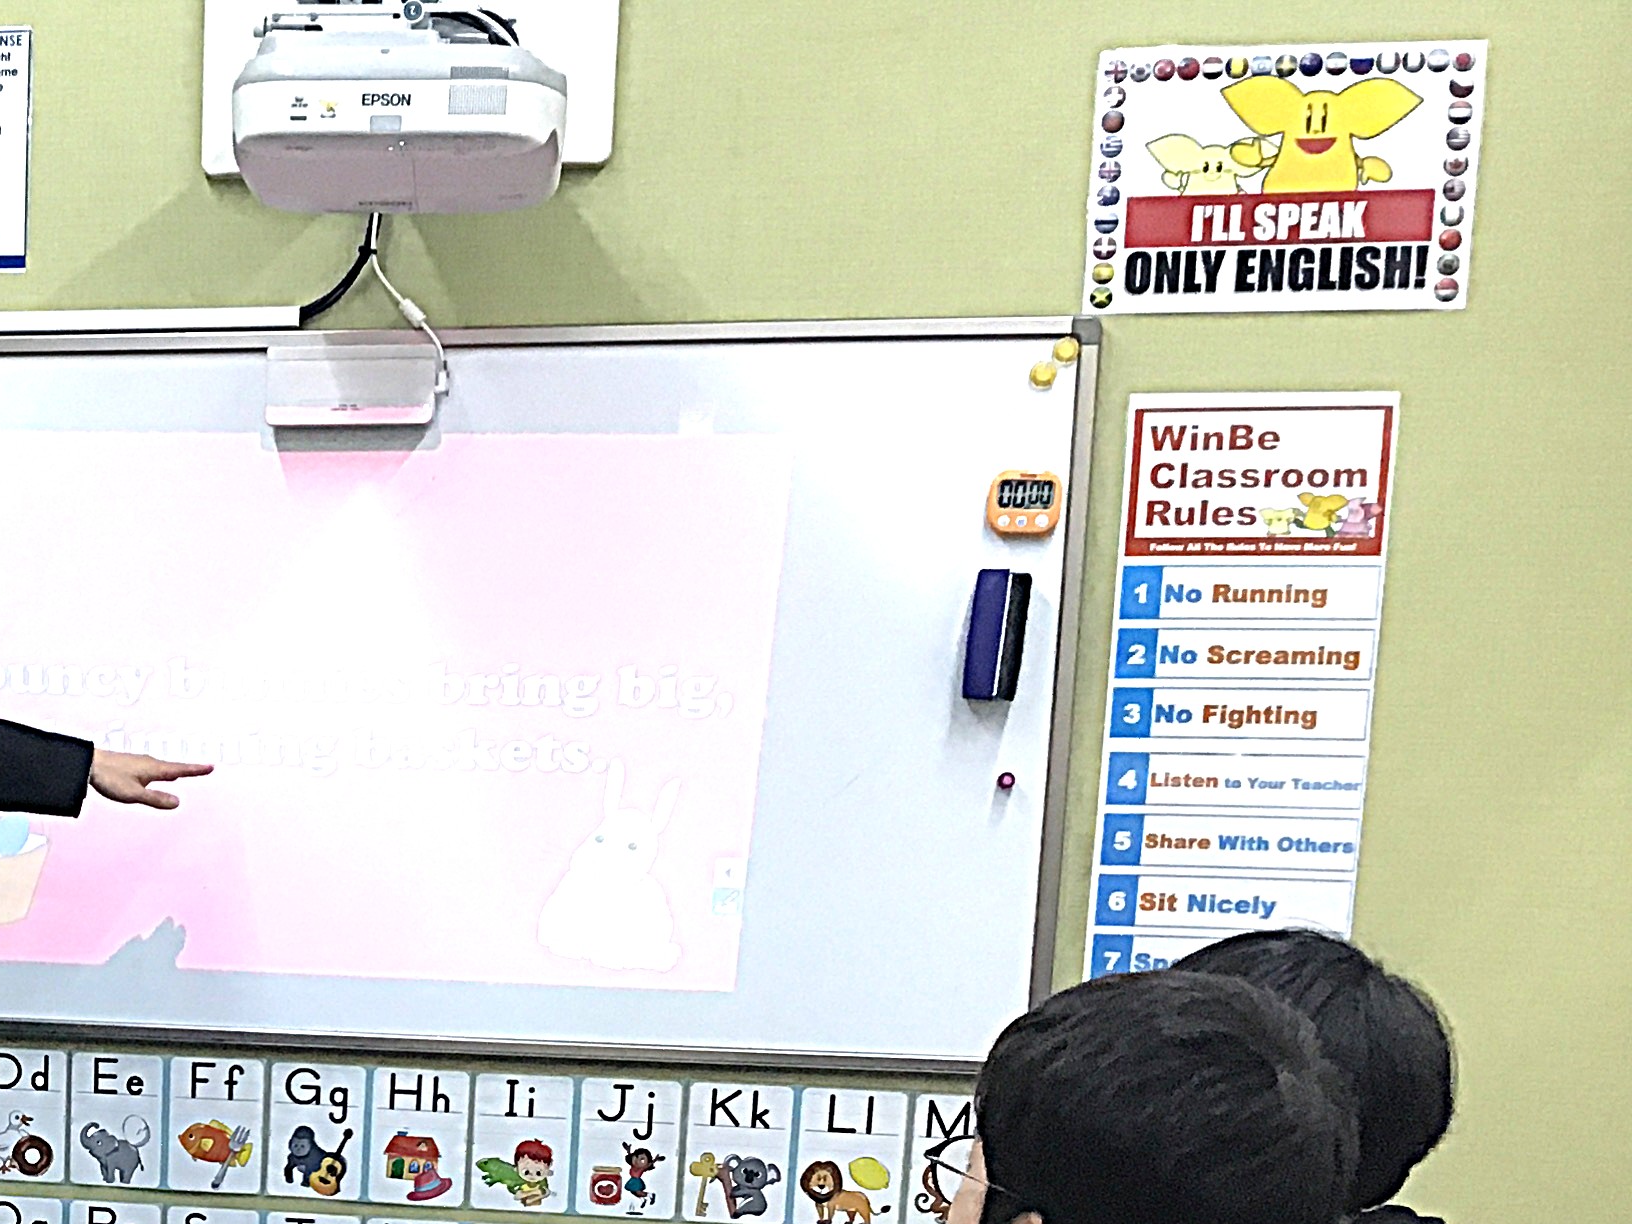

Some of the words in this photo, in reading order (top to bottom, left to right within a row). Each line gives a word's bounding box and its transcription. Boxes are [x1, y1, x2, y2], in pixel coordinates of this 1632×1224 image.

[361, 93, 411, 106] EPSON
[1191, 204, 1246, 242] I'LL
[1253, 200, 1368, 241] SPEAK
[1124, 250, 1226, 296] ONLY
[1234, 245, 1429, 293] ENGLISH!
[1150, 424, 1280, 451] WinBe
[1150, 462, 1367, 489] Classroom
[1145, 499, 1257, 526] Rules
[1134, 583, 1148, 603] 1
[1164, 584, 1202, 603] No
[1212, 584, 1328, 608] Running
[1127, 646, 1147, 665] 2
[1159, 645, 1198, 664] No
[1207, 645, 1360, 671] Screaming
[430, 661, 601, 718] bring
[616, 663, 734, 720] big,
[1122, 703, 1141, 724] 3
[1154, 704, 1193, 724] No
[1202, 704, 1318, 730] Fighting
[1117, 769, 1137, 790] 4
[1150, 772, 1219, 788] Listen
[1224, 778, 1242, 789] to
[1247, 777, 1286, 790] Your
[1291, 778, 1363, 791] Teacher
[1113, 831, 1131, 851] 5
[1145, 833, 1211, 850] Share
[1218, 834, 1269, 851] With
[1277, 836, 1356, 854] Others
[1108, 891, 1127, 911] 6
[1139, 892, 1178, 912] Sit
[1187, 894, 1277, 920] Nicely
[1104, 952, 1121, 971] 7
[93, 1057, 144, 1096] Ee
[191, 1061, 248, 1101] Ff
[285, 1068, 351, 1124] Gg
[388, 1072, 450, 1113] Hh
[504, 1079, 535, 1118] Ii
[597, 1084, 655, 1141] Jj
[709, 1088, 773, 1129] Kk
[827, 1094, 874, 1135] Ll
